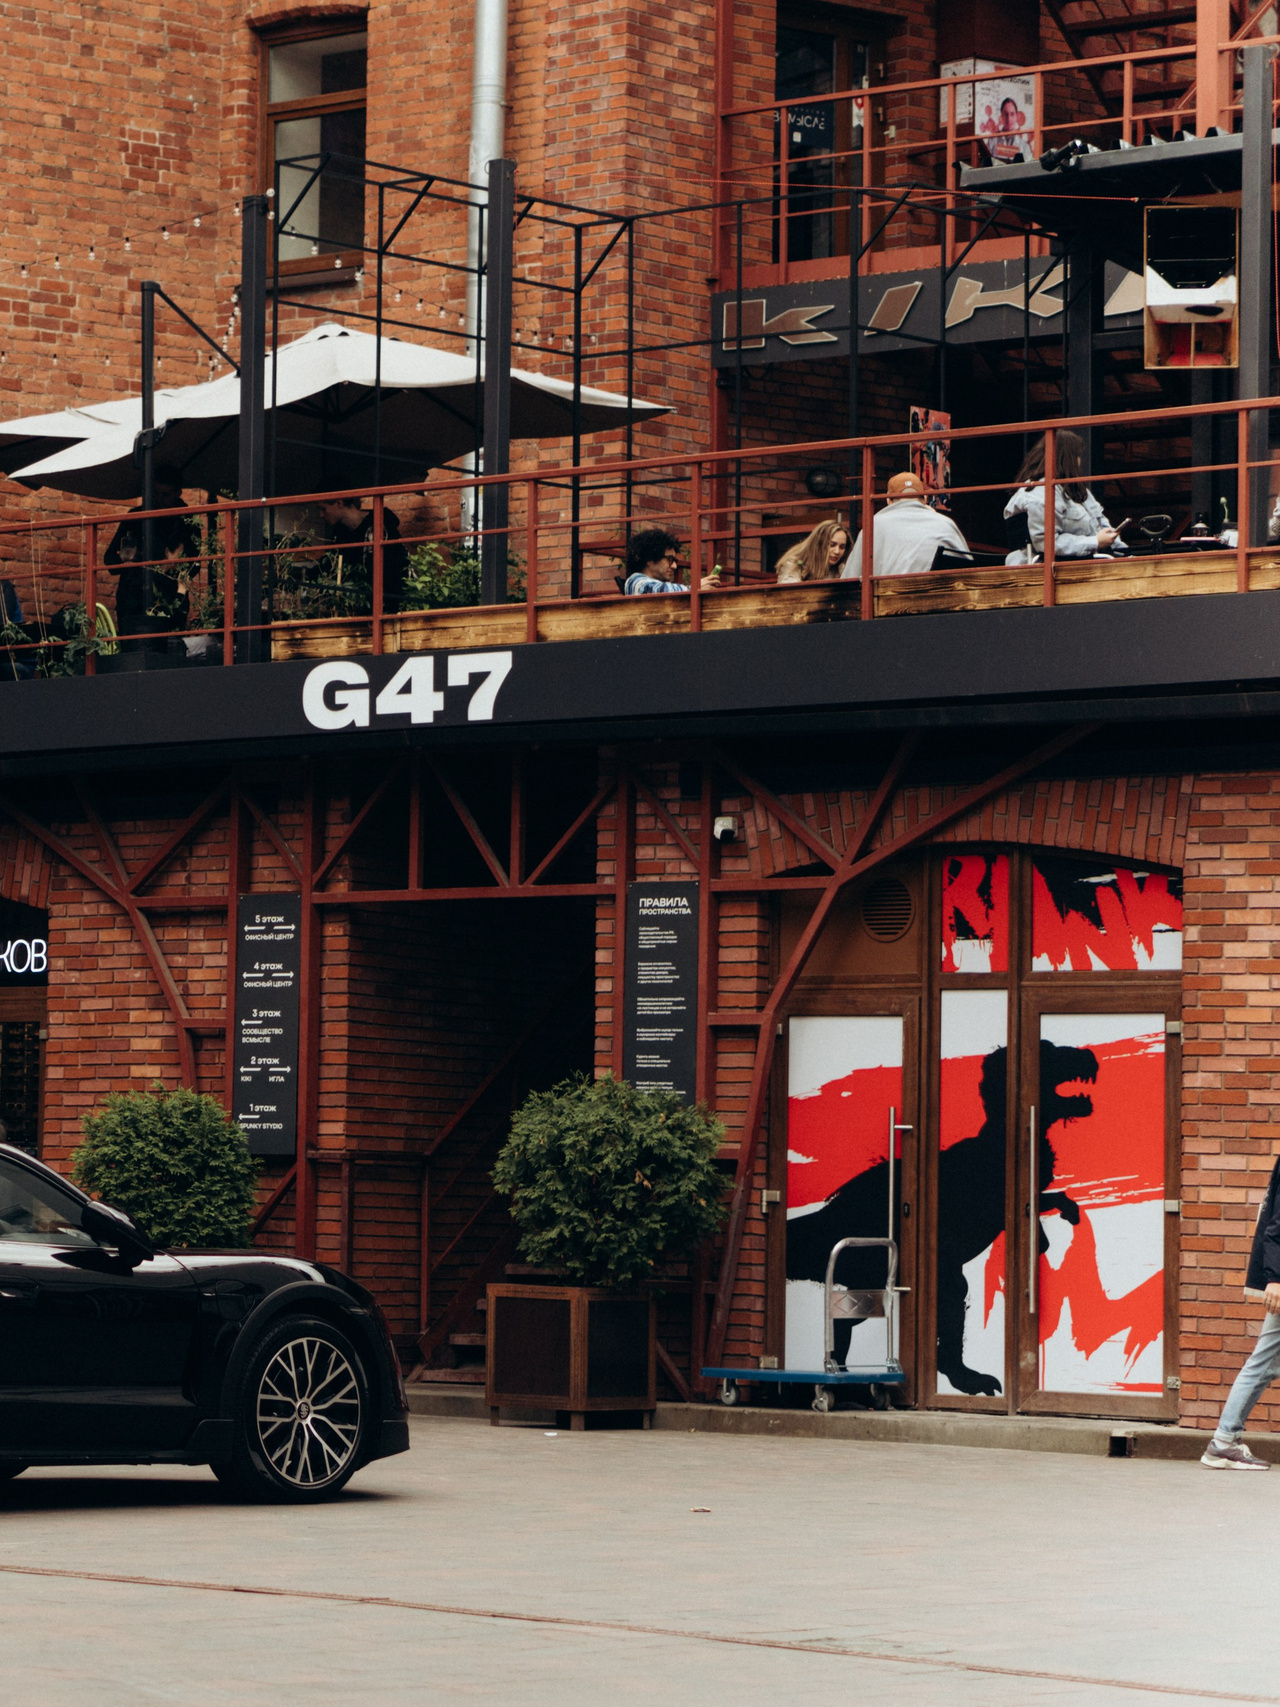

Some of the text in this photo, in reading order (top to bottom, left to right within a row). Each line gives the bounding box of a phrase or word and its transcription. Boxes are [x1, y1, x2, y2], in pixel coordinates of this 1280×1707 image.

[302, 650, 513, 731] G47
[639, 897, 689, 908] ПРАВИЛА
[639, 908, 692, 916] ПРОСТРАНСТВА
[255, 915, 285, 923] 5 этаж
[274, 933, 294, 941] ЦЕНТР
[253, 962, 259, 970] 4
[273, 980, 293, 988] ЦЕНТР
[252, 1009, 258, 1017] 3
[250, 1056, 256, 1065] 2
[249, 1103, 254, 1112] 1
